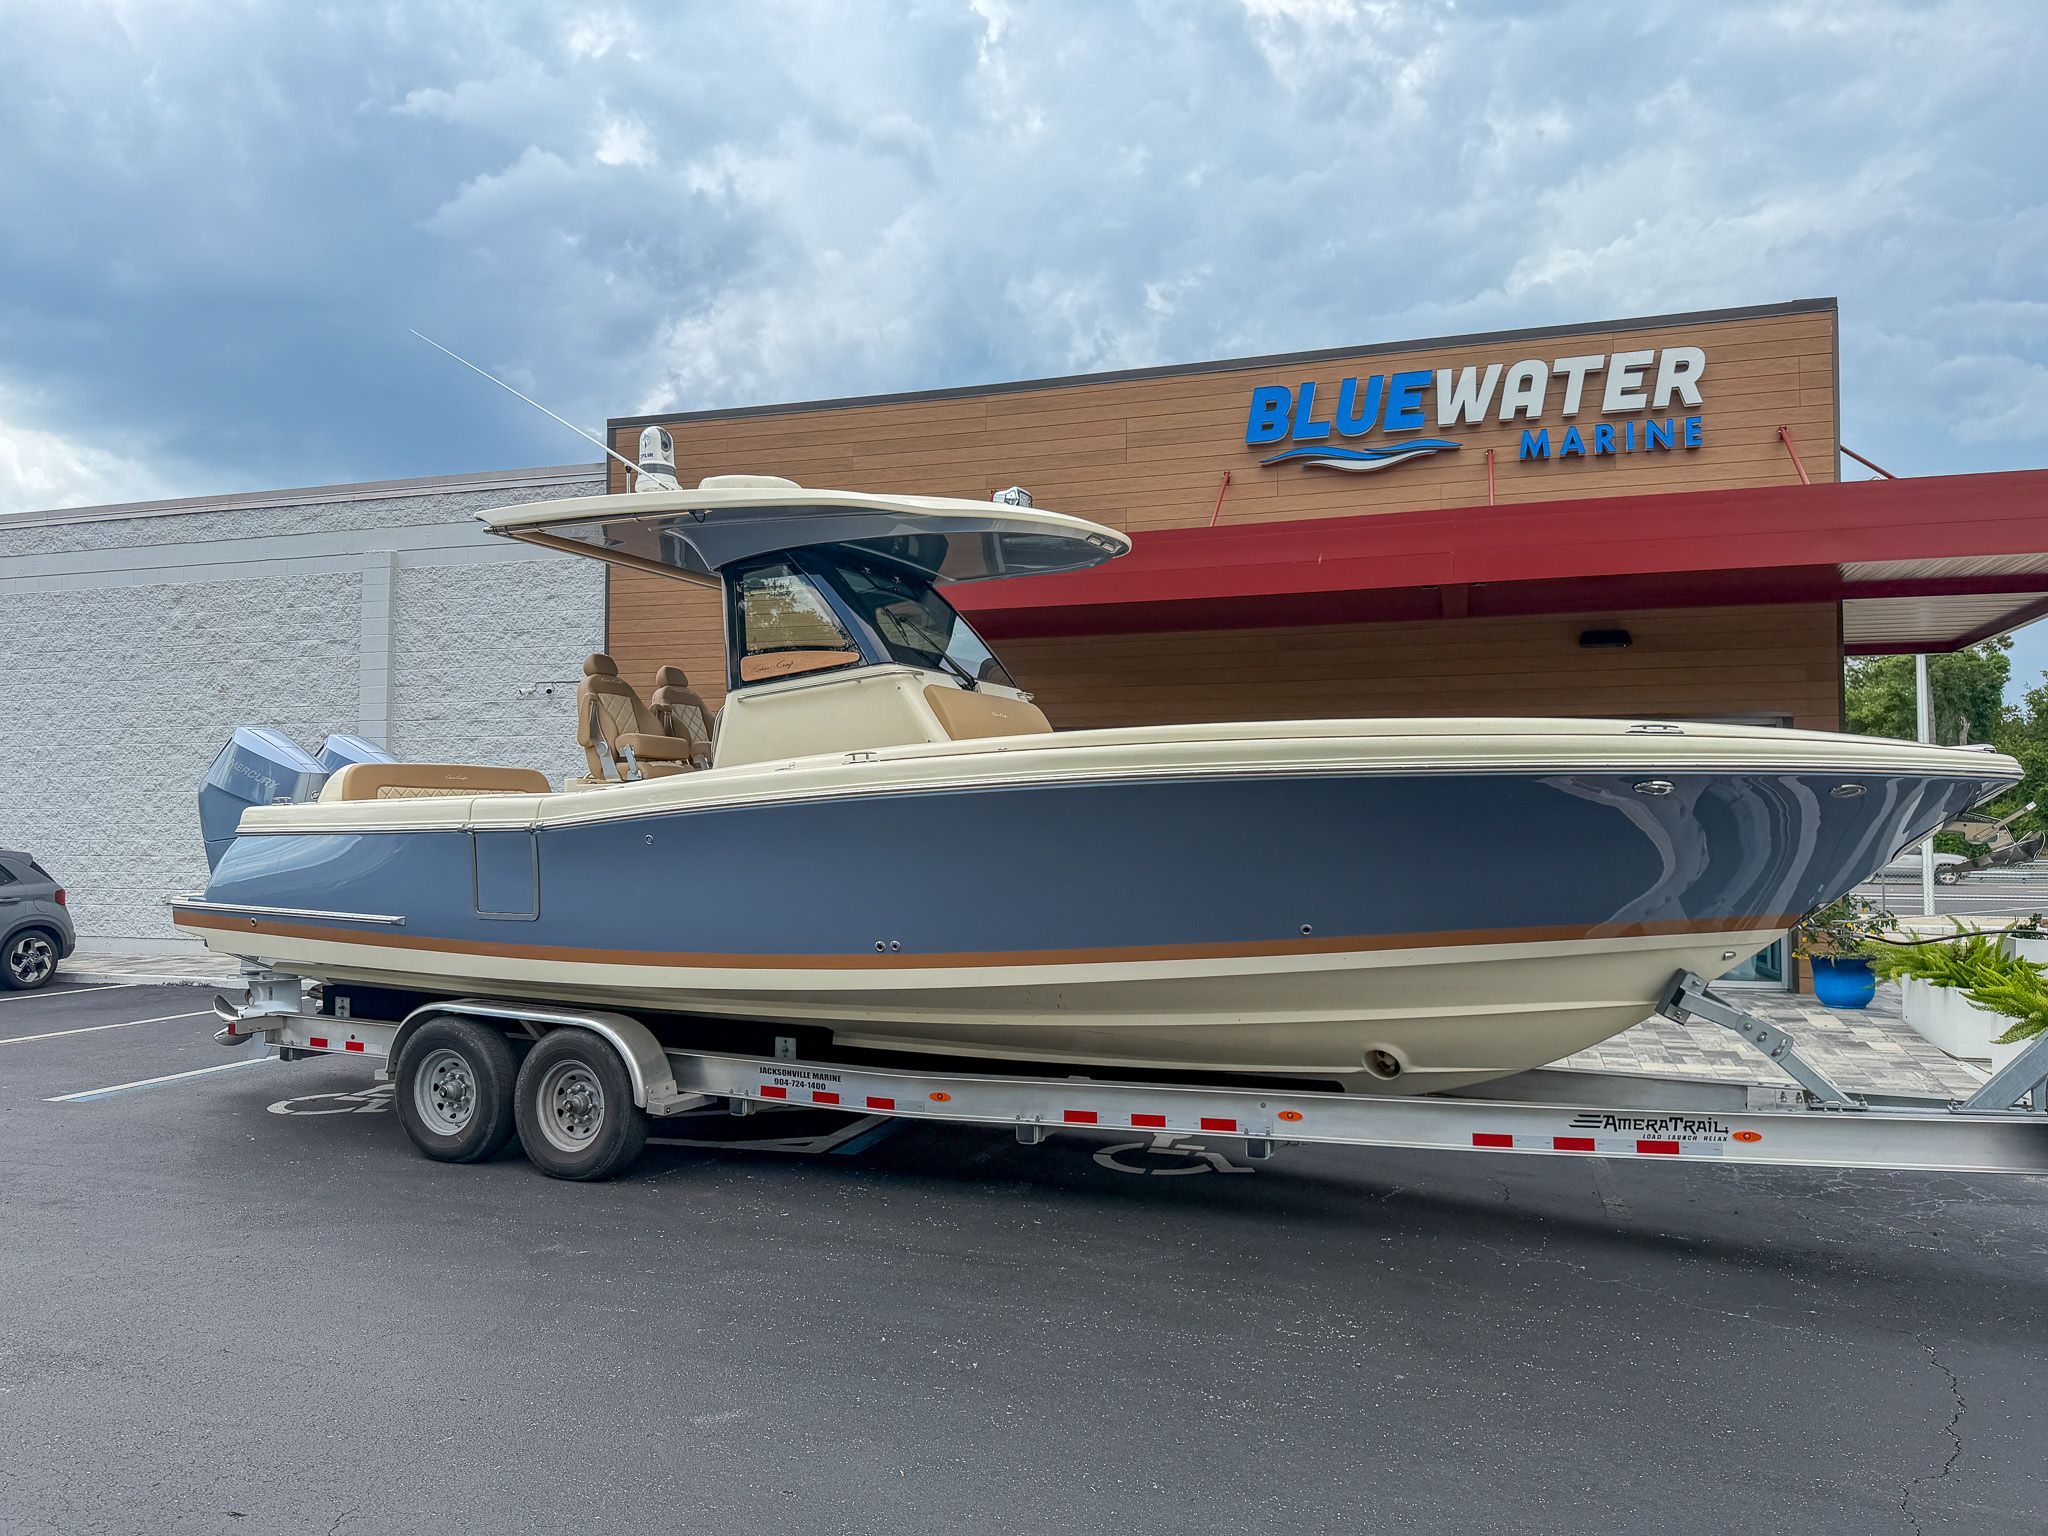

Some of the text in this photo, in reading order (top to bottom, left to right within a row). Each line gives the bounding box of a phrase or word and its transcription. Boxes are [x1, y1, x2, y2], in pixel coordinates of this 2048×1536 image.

[1520, 417, 1703, 460] MARINE
[228, 759, 280, 789] MERCURY
[759, 1066, 842, 1083] JACKSONVILLE MARINE
[774, 1078, 826, 1091] 904-724-1400
